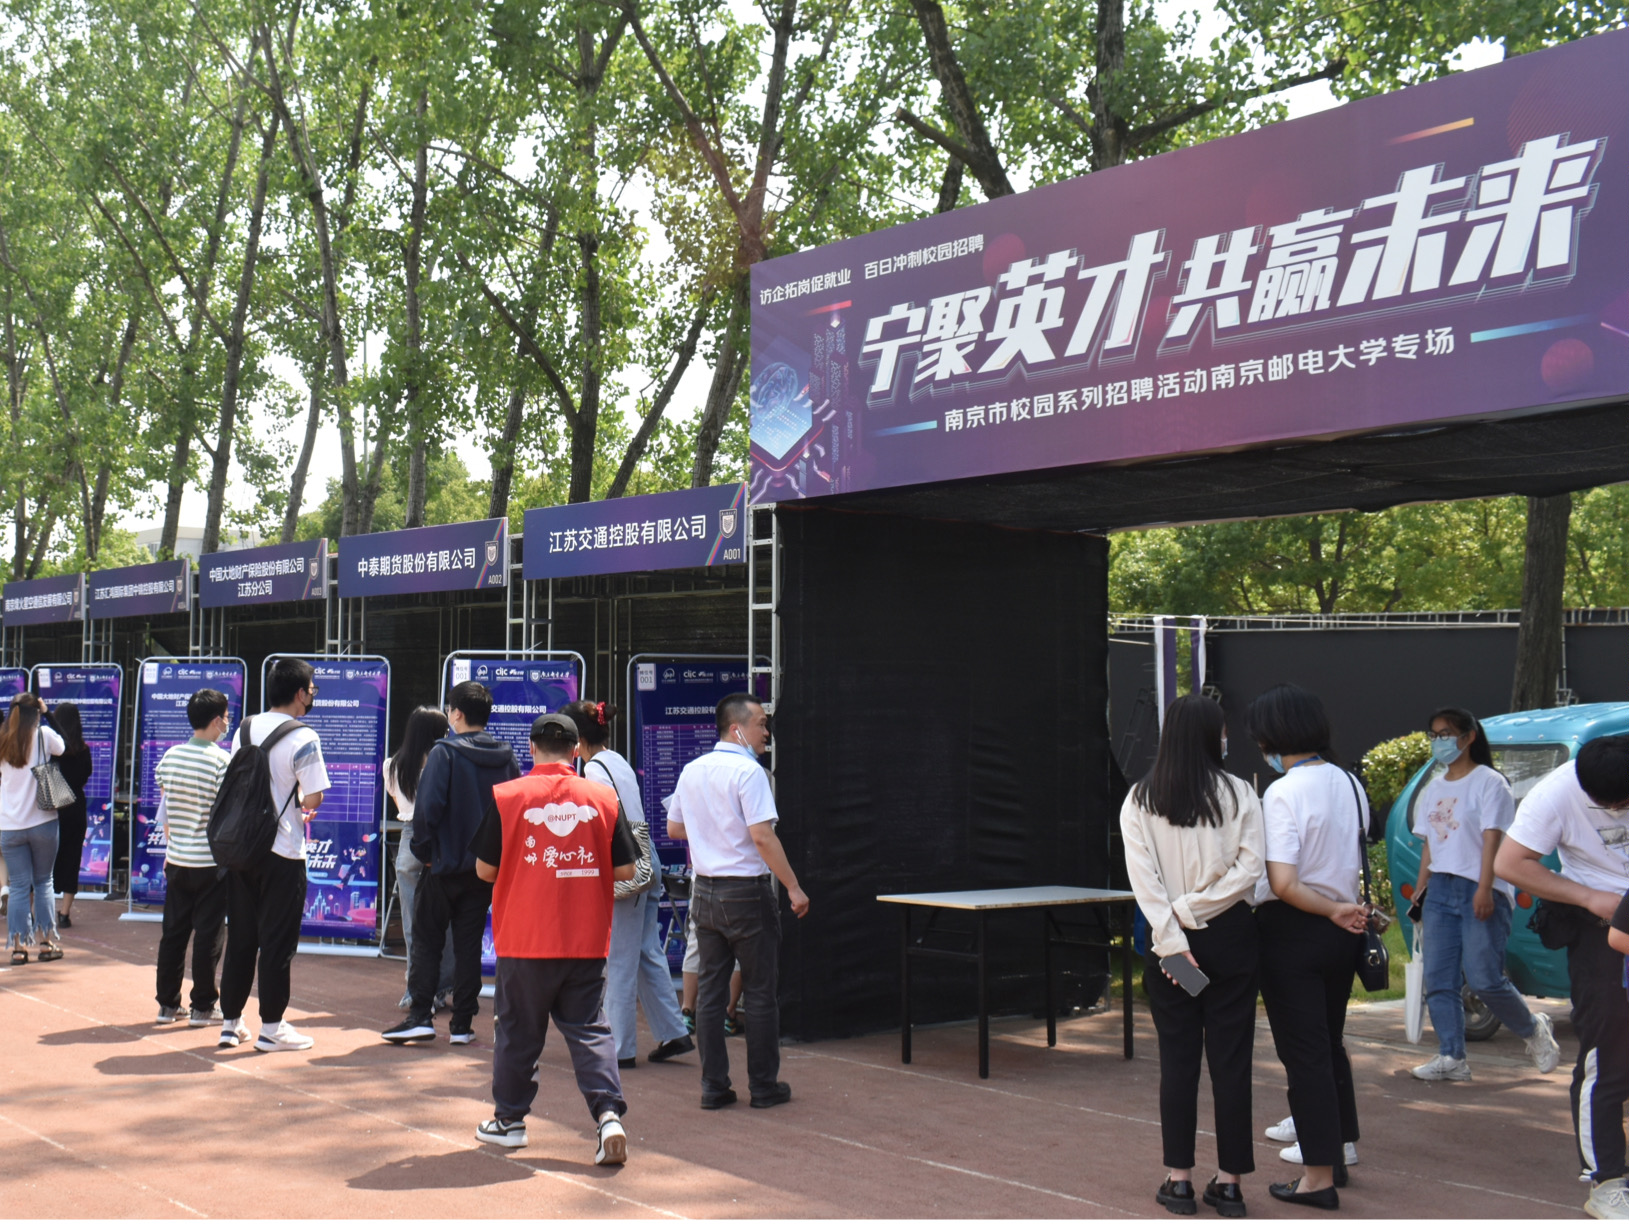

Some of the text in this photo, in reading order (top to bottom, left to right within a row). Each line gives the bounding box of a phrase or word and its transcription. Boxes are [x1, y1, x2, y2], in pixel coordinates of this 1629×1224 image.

[759, 234, 985, 306] 访企拓岗促就业 百日冲刺校园招聘
[861, 134, 1602, 393] 宁聚英才 共赢未来
[944, 326, 1456, 433] 南京市校园系列招聘活动南京邮电大学专场
[549, 514, 707, 554] 江苏交通控股有限公司
[357, 547, 476, 578] 中泰期货股份有限公司
[723, 548, 741, 561] A001
[209, 557, 305, 581] 中国大地财产保险股份有限公司
[488, 574, 502, 585] A002
[237, 580, 273, 598] 江苏分公司
[547, 813, 576, 823] @NUPT
